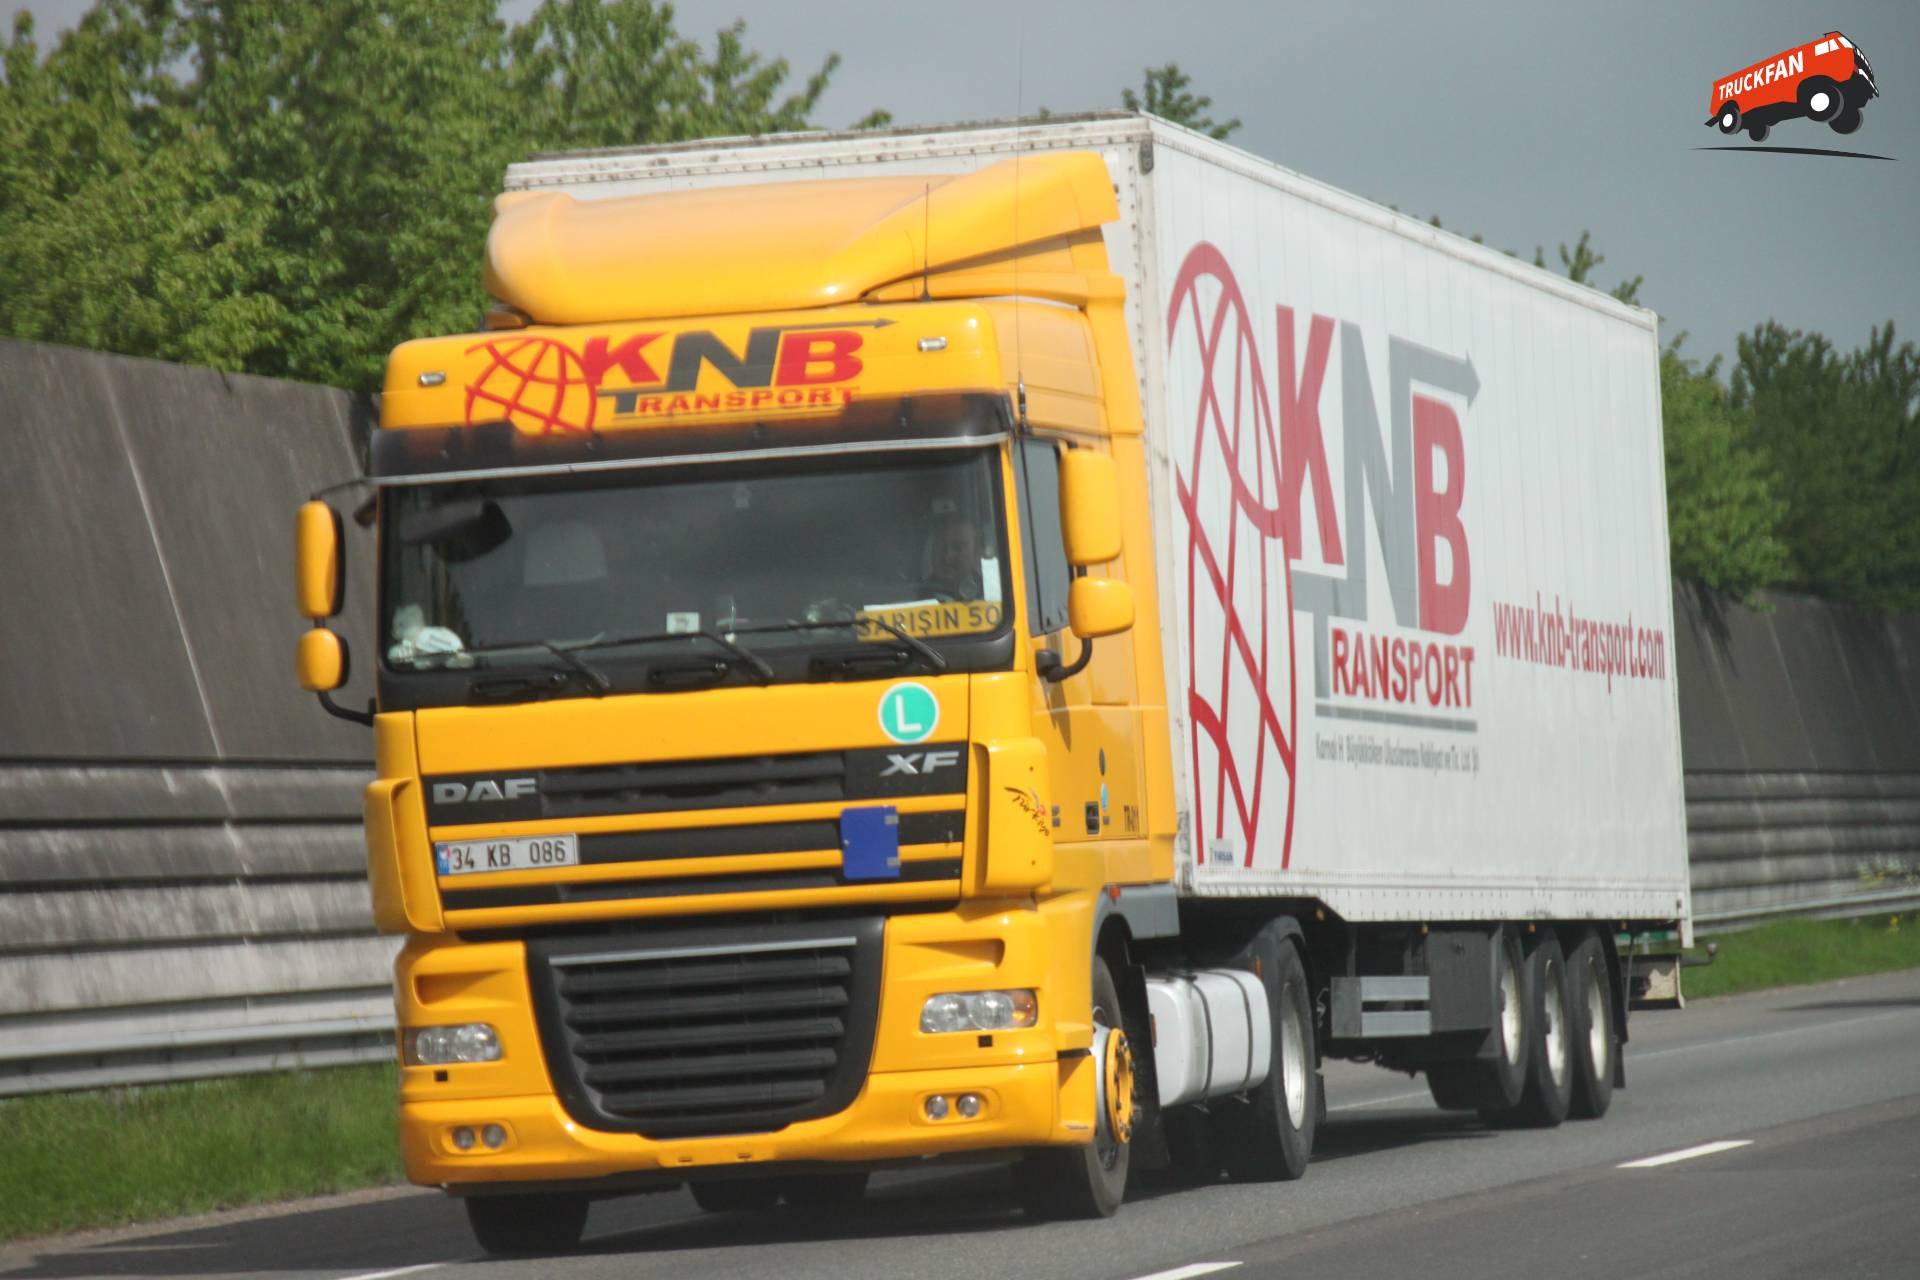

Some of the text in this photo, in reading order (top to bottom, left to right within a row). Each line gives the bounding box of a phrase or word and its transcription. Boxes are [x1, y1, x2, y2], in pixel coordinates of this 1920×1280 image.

[582, 328, 864, 391] KNB
[597, 386, 860, 414] TRANSPORT
[1276, 303, 1471, 636] KNB
[968, 605, 1000, 627] 50
[1291, 572, 1475, 708] TRANSPORT
[1493, 590, 1665, 696] www.knb-transport.com
[895, 694, 922, 735] L
[879, 750, 960, 776] XF
[433, 778, 537, 804] DAF
[452, 840, 566, 870] 34 KB 086
